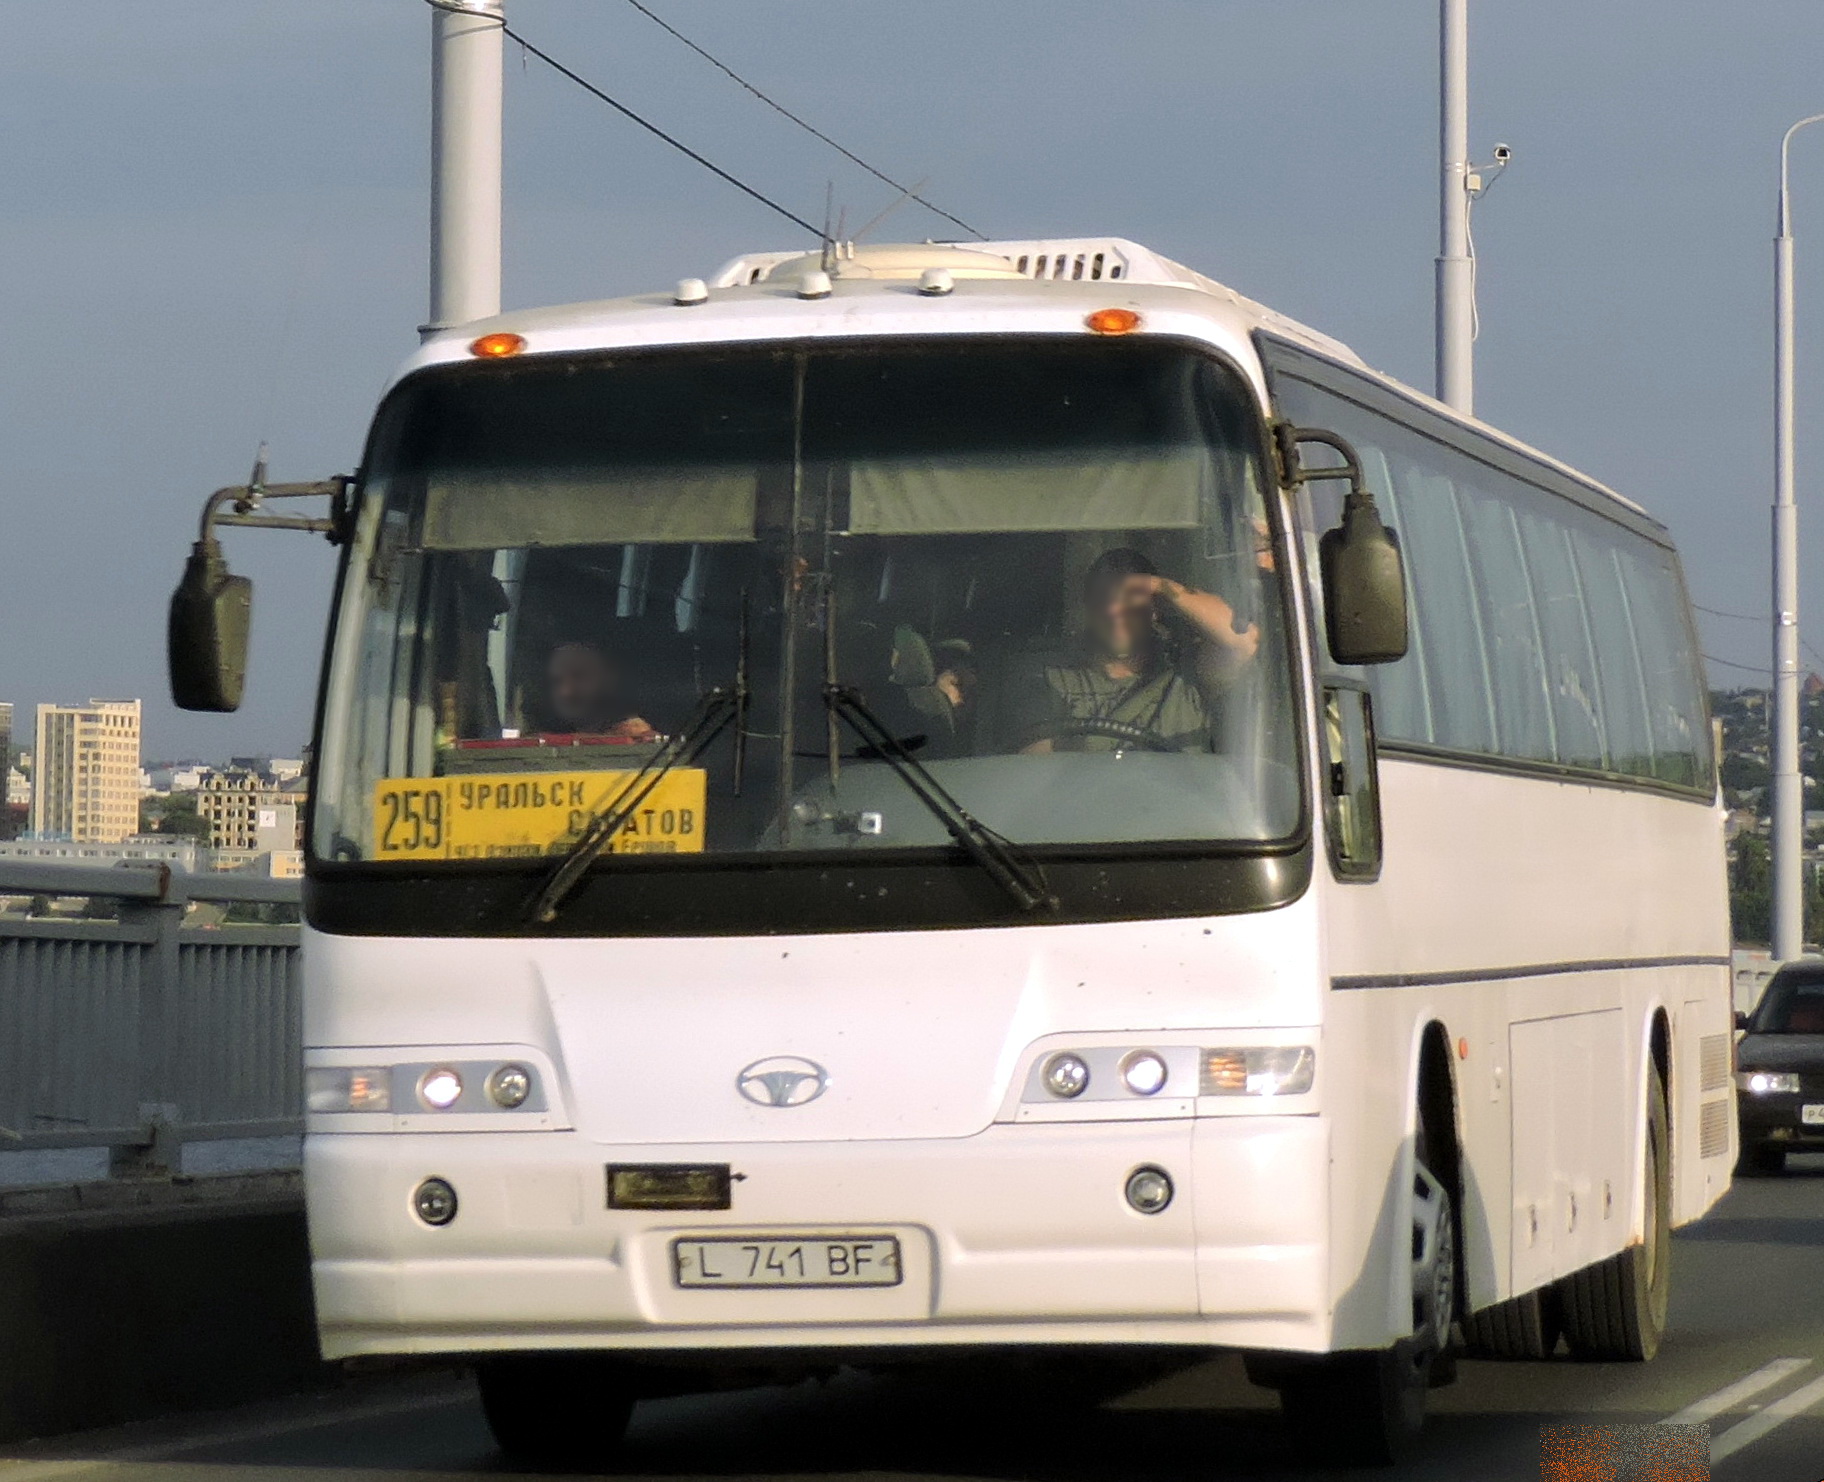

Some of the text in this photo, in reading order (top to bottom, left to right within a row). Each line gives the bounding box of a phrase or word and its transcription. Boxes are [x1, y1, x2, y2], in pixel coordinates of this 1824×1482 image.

[460, 780, 585, 810] УРАЛЬСК
[381, 790, 443, 851] 259
[699, 1244, 874, 1278] L 741 BF
